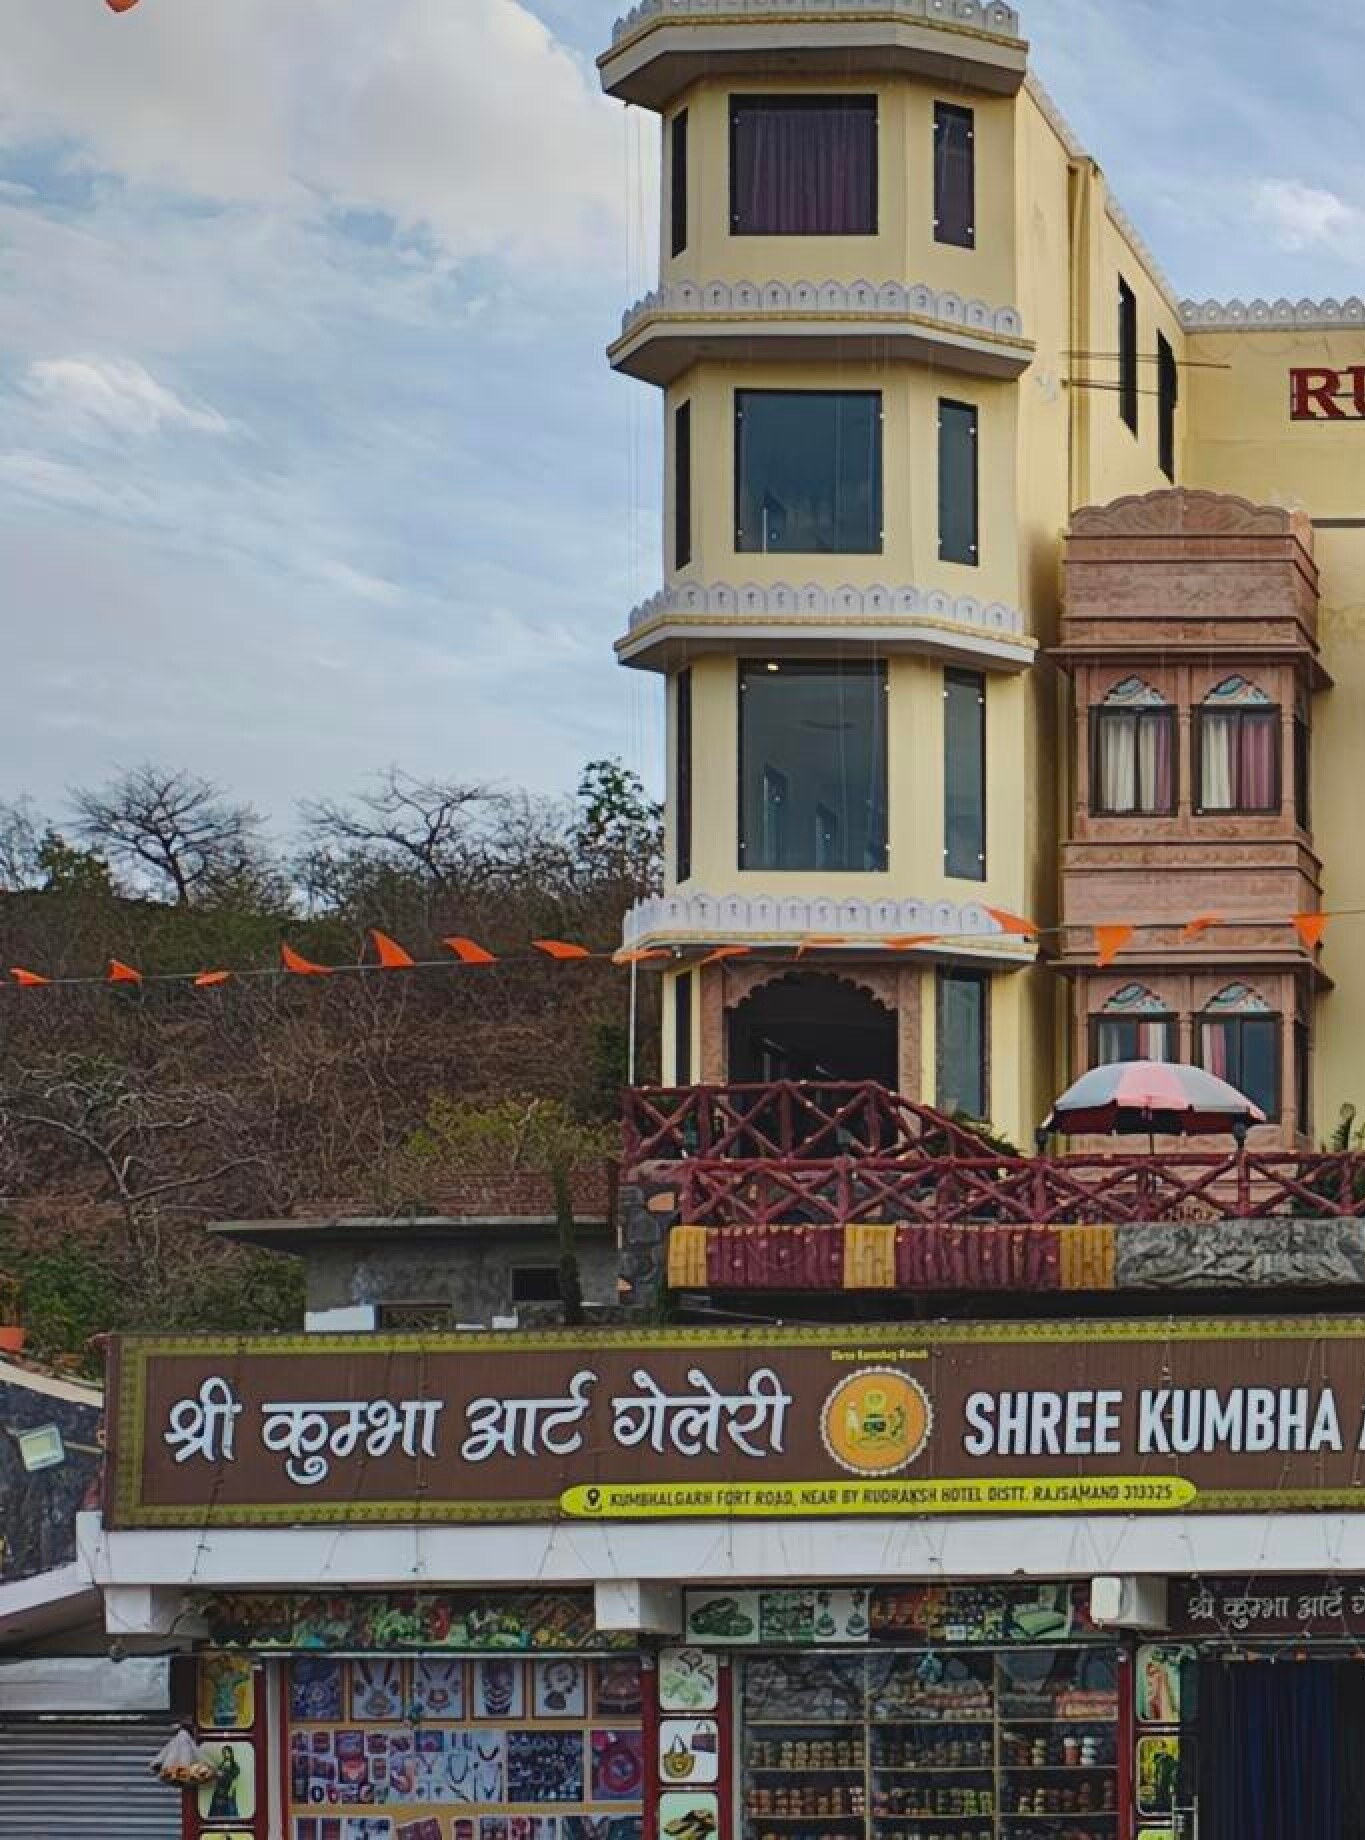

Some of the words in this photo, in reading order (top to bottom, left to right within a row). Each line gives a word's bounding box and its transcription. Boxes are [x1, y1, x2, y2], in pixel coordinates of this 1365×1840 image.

[165, 1375, 242, 1463] श्री
[262, 1397, 444, 1486] कुम्भा
[463, 1369, 598, 1462] आर्ट
[613, 1367, 793, 1457] गेलेरी
[963, 1390, 1121, 1458] SHREE
[1139, 1388, 1343, 1456] KUMBHA
[717, 1491, 751, 1505] FORT
[802, 1489, 837, 1504] NEAR
[842, 1489, 859, 1504] BY
[862, 1488, 937, 1503] RUDRAKSH
[941, 1487, 982, 1502] HOTEL
[1033, 1485, 1119, 1501] RAJSAMAND
[1123, 1484, 1172, 1500] 313325
[1187, 1587, 1215, 1621] श्री
[1223, 1597, 1290, 1629] कुम्भा
[1298, 1585, 1344, 1621] आर्ट
